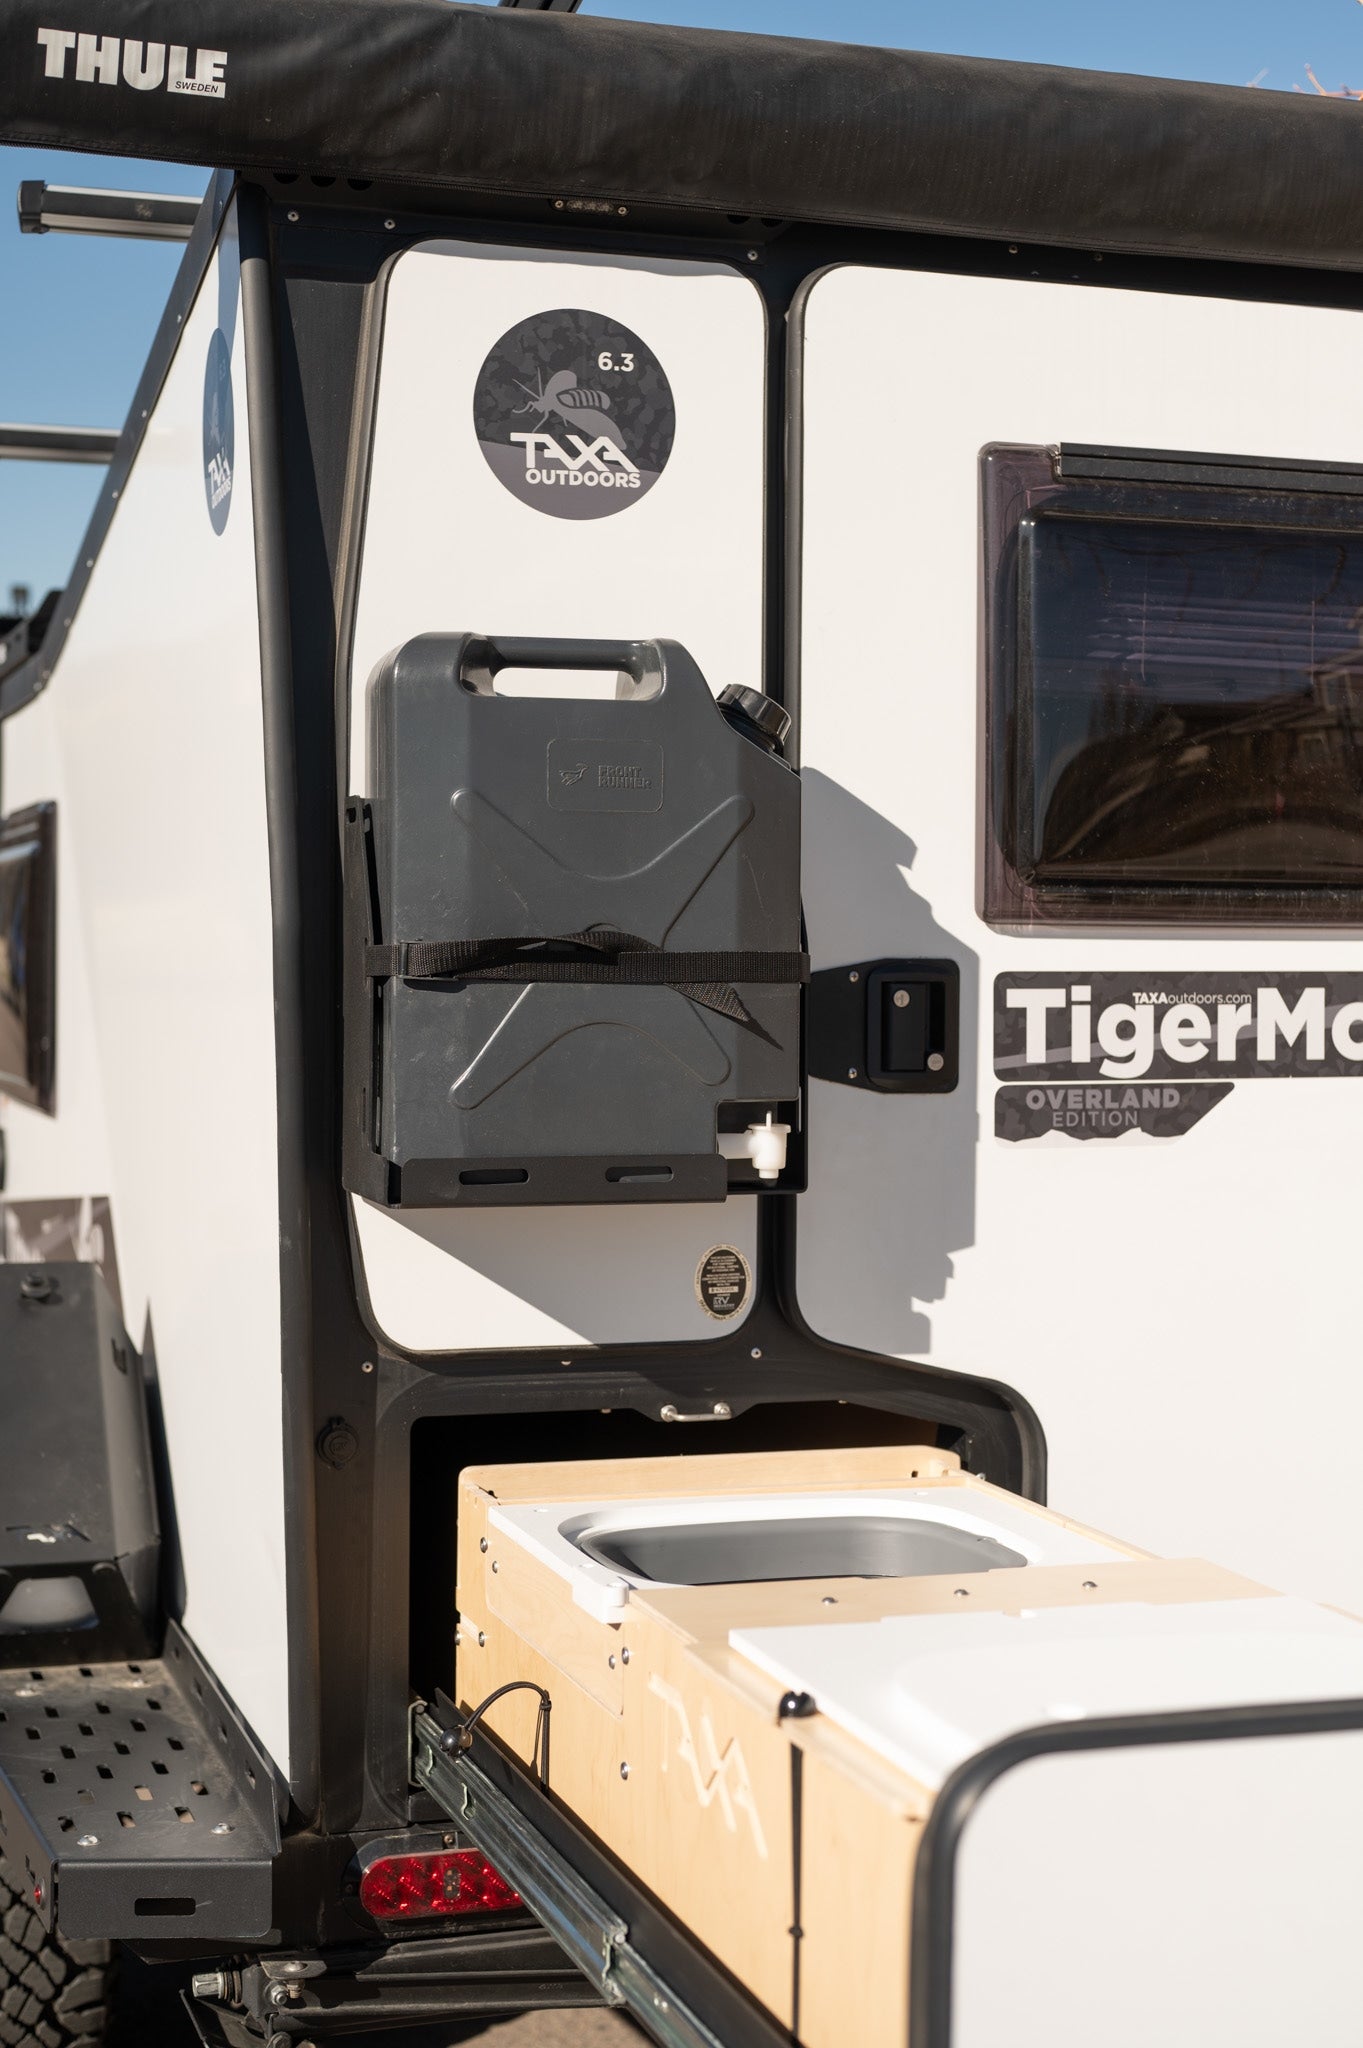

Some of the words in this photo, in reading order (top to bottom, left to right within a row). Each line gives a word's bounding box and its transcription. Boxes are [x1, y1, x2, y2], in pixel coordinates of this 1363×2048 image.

[37, 27, 228, 98] THULE
[175, 80, 219, 94] SWEDEN
[598, 351, 635, 372] 6.3
[510, 432, 640, 473] TAXA
[525, 469, 641, 489] OUTDOORS
[598, 764, 642, 778] FRONT
[598, 776, 652, 790] RUNNER
[1133, 991, 1252, 1006] TAXAoutdoors.com
[1025, 1087, 1181, 1110] OVERLAND
[1052, 1110, 1138, 1127] EDITION
